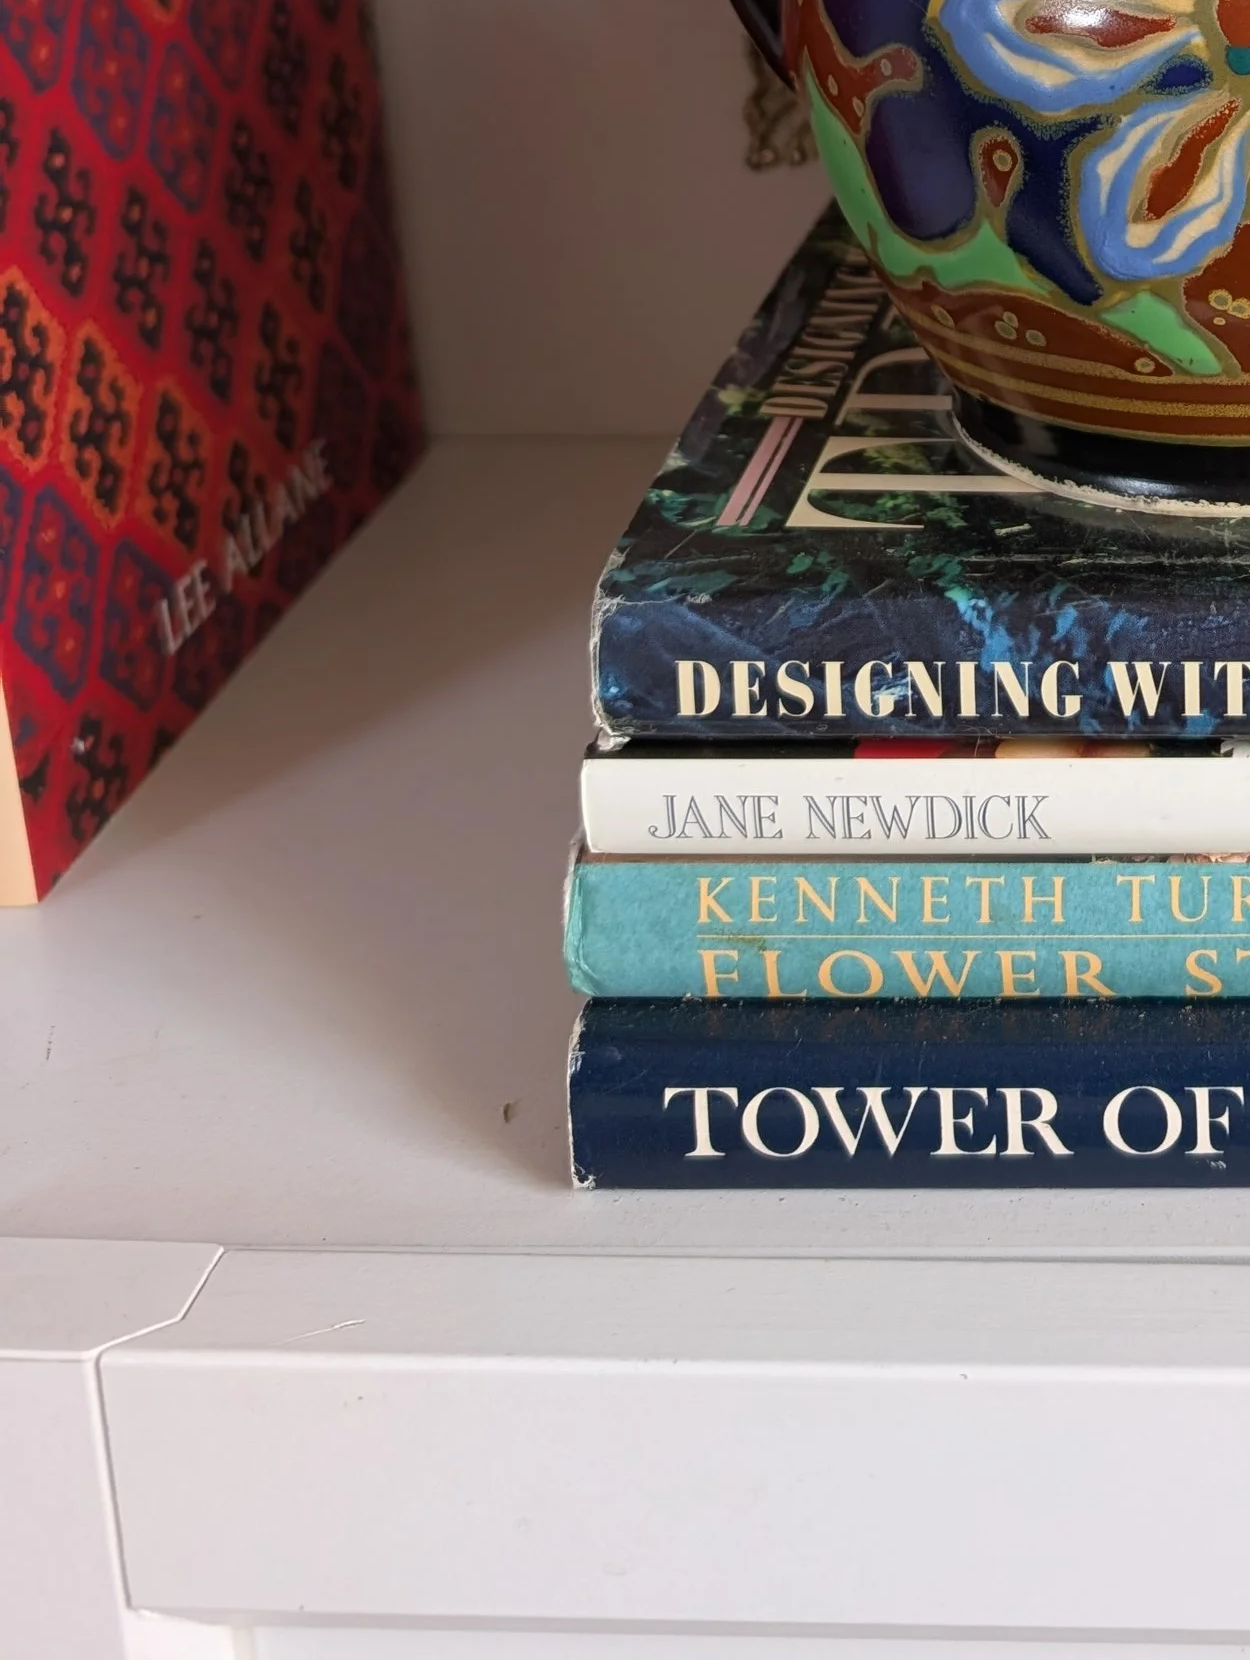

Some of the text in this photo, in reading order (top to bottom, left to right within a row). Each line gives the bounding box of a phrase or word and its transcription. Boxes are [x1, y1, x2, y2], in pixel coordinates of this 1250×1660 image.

[156, 439, 334, 656] LEE ALLANE
[674, 659, 1083, 719] DESIGNING
[648, 795, 1052, 840] JANE NEWDICK
[697, 876, 1066, 923] KENNETH
[697, 949, 1116, 998] FLOWER
[663, 1087, 1074, 1157] TOWER
[1103, 1086, 1244, 1155] OF
